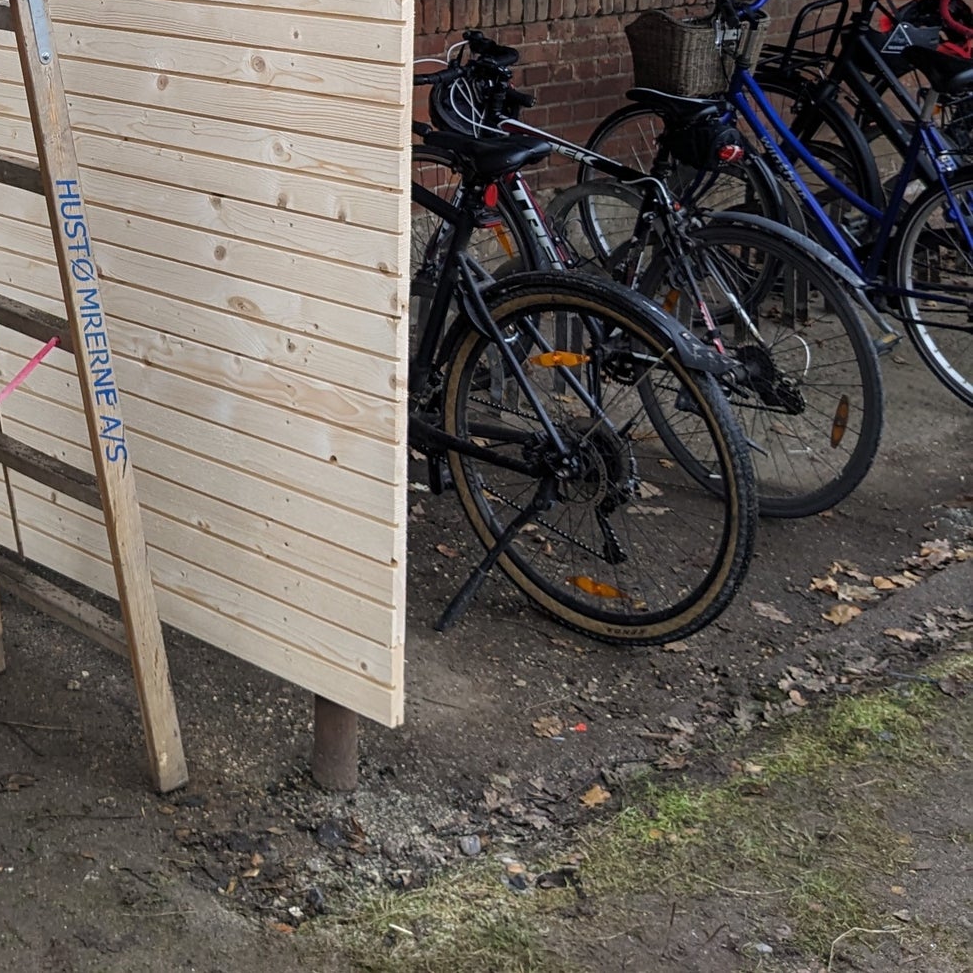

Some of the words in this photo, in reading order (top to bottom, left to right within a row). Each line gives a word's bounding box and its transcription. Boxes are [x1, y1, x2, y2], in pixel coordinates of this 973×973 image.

[549, 143, 598, 166] EK
[512, 179, 564, 271] TRE
[98, 414, 127, 464] A/S
